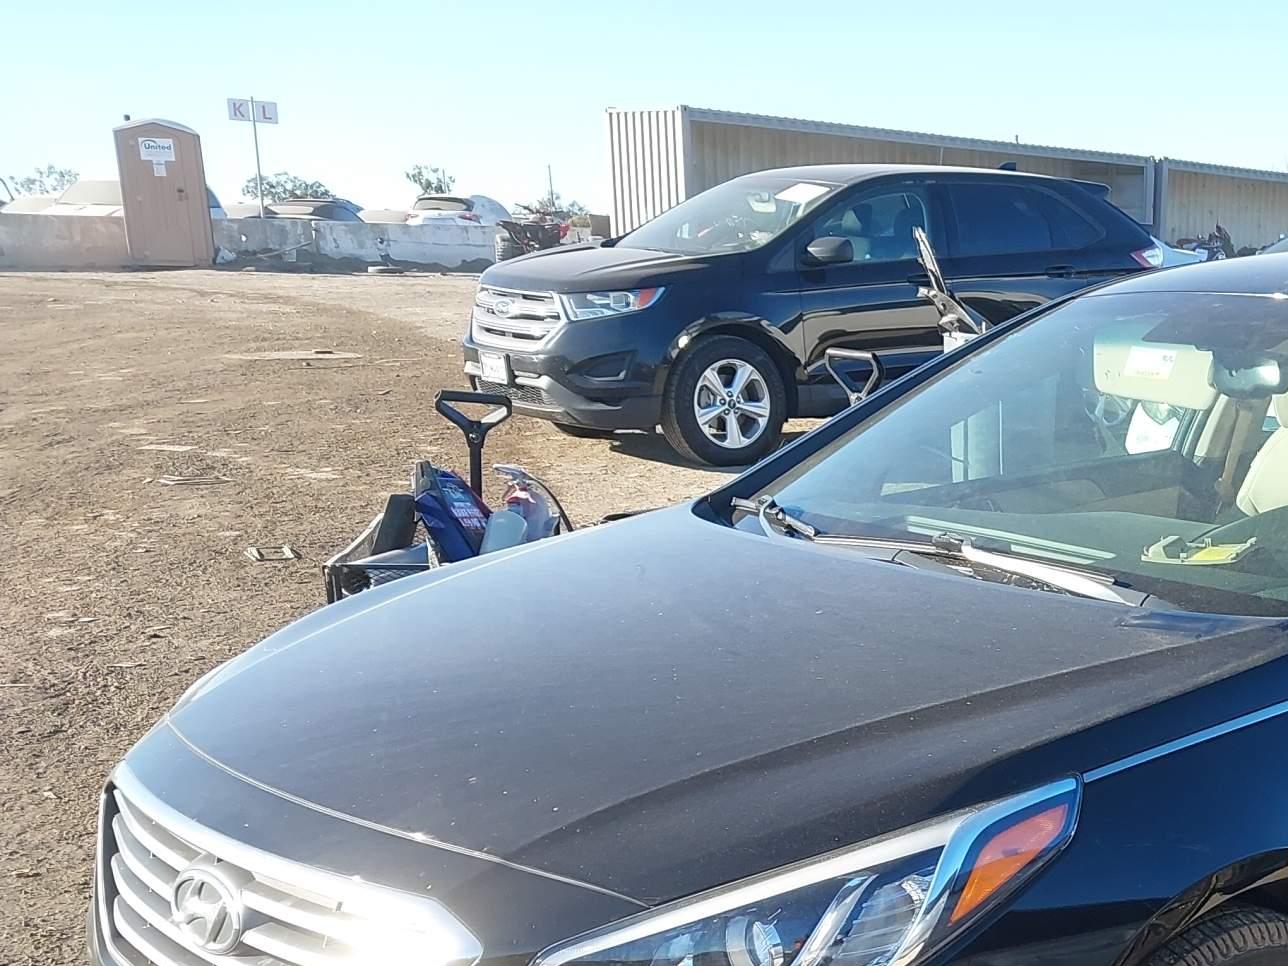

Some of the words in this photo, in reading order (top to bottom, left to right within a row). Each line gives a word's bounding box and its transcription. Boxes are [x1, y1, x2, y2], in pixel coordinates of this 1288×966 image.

[232, 102, 246, 118] K
[262, 105, 273, 120] L
[143, 143, 172, 151] United
